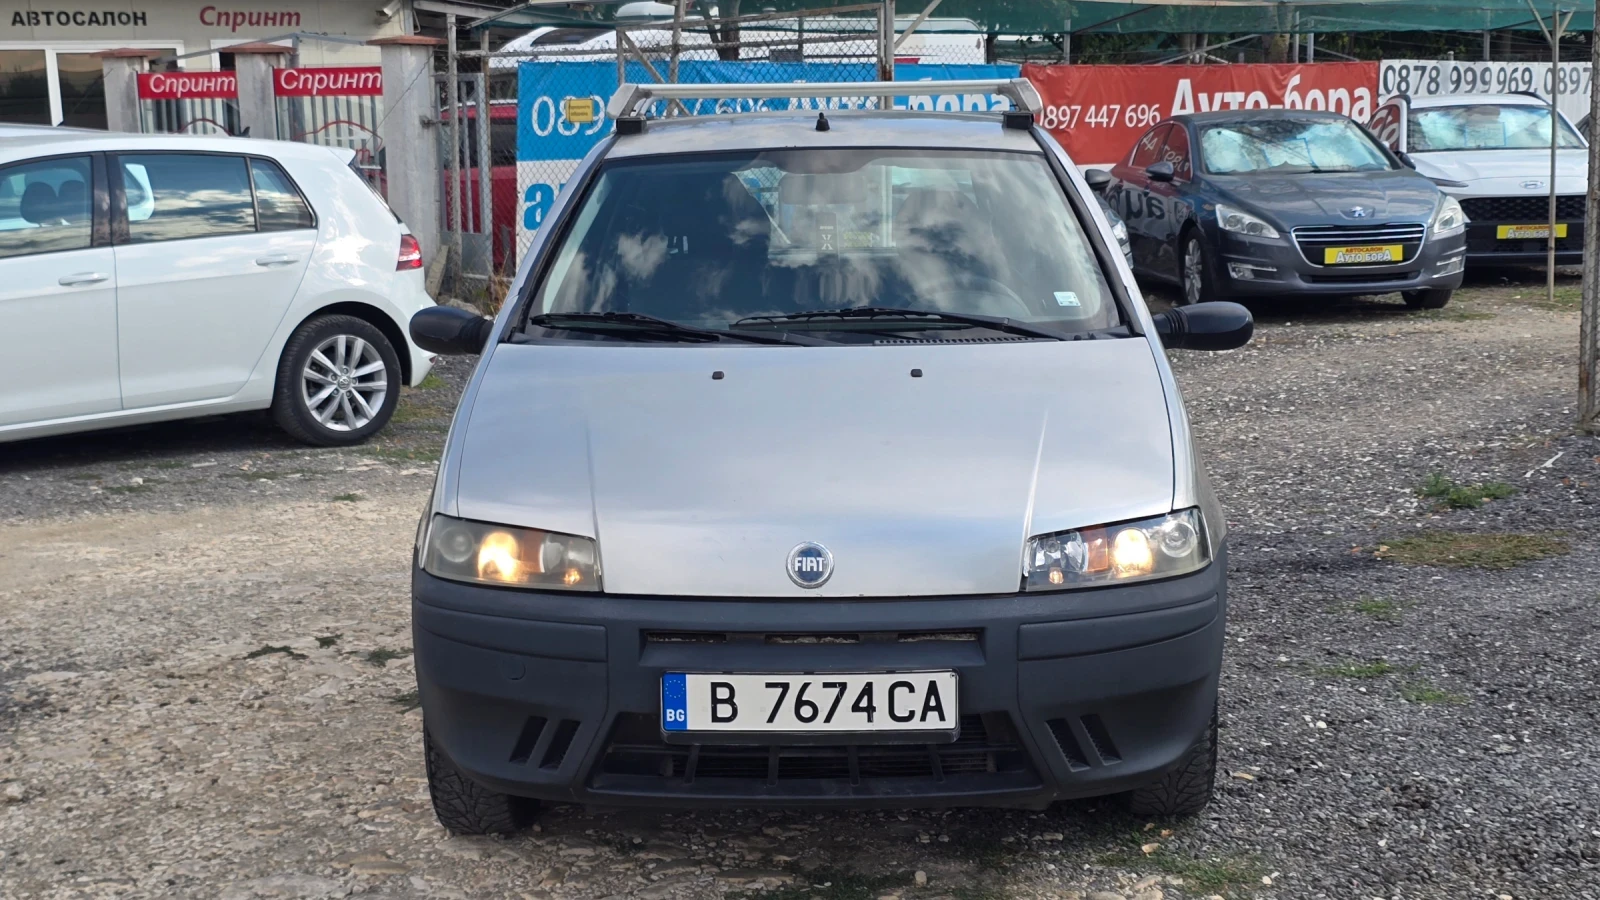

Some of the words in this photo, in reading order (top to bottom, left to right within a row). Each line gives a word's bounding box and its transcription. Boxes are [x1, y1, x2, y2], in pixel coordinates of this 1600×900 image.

[11, 11, 147, 27] АВТОСАЛОН
[199, 6, 301, 32] Спринт
[150, 74, 236, 98] Спринт
[280, 69, 382, 95] Спринт
[1382, 64, 1441, 95] 0878
[1449, 65, 1493, 94] 999
[1084, 104, 1121, 128] 447
[1125, 104, 1161, 128] 696
[794, 556, 825, 572] FIAT
[710, 681, 738, 723] B
[764, 681, 877, 723] 7674
[887, 680, 946, 723] CA
[666, 709, 685, 721] BG
